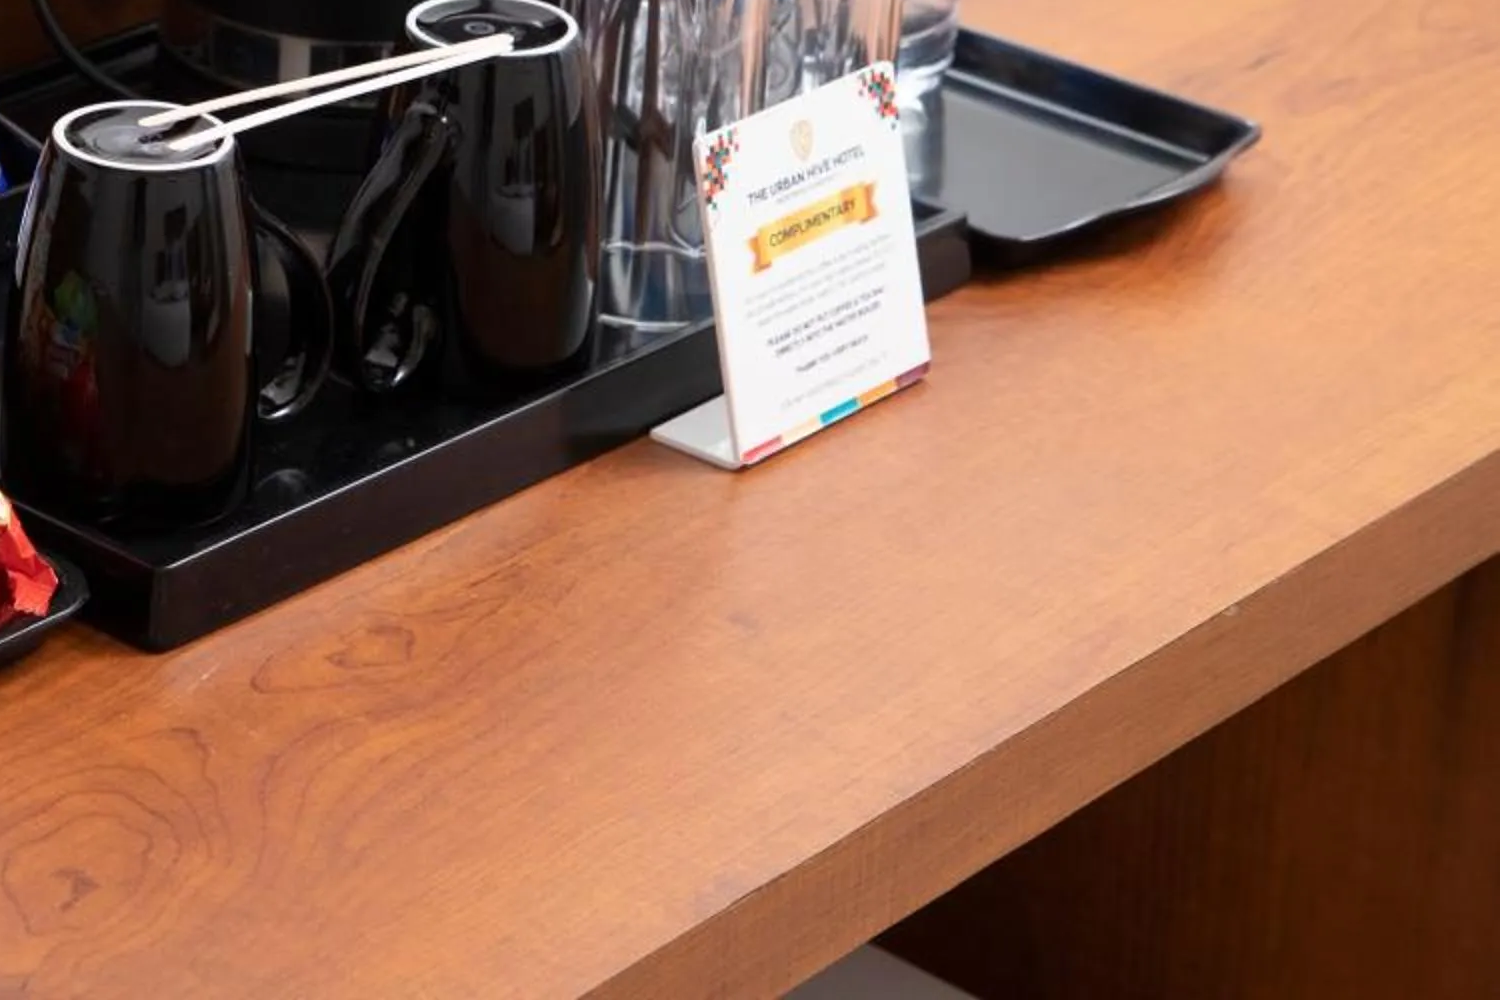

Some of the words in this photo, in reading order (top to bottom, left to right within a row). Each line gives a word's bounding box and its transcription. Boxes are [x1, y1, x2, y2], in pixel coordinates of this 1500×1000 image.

[747, 187, 768, 206] THE
[769, 170, 805, 195] URBAN
[806, 158, 831, 177] HIVE
[832, 144, 865, 167] HOTEL
[769, 198, 856, 248] COMPLIMENTARY
